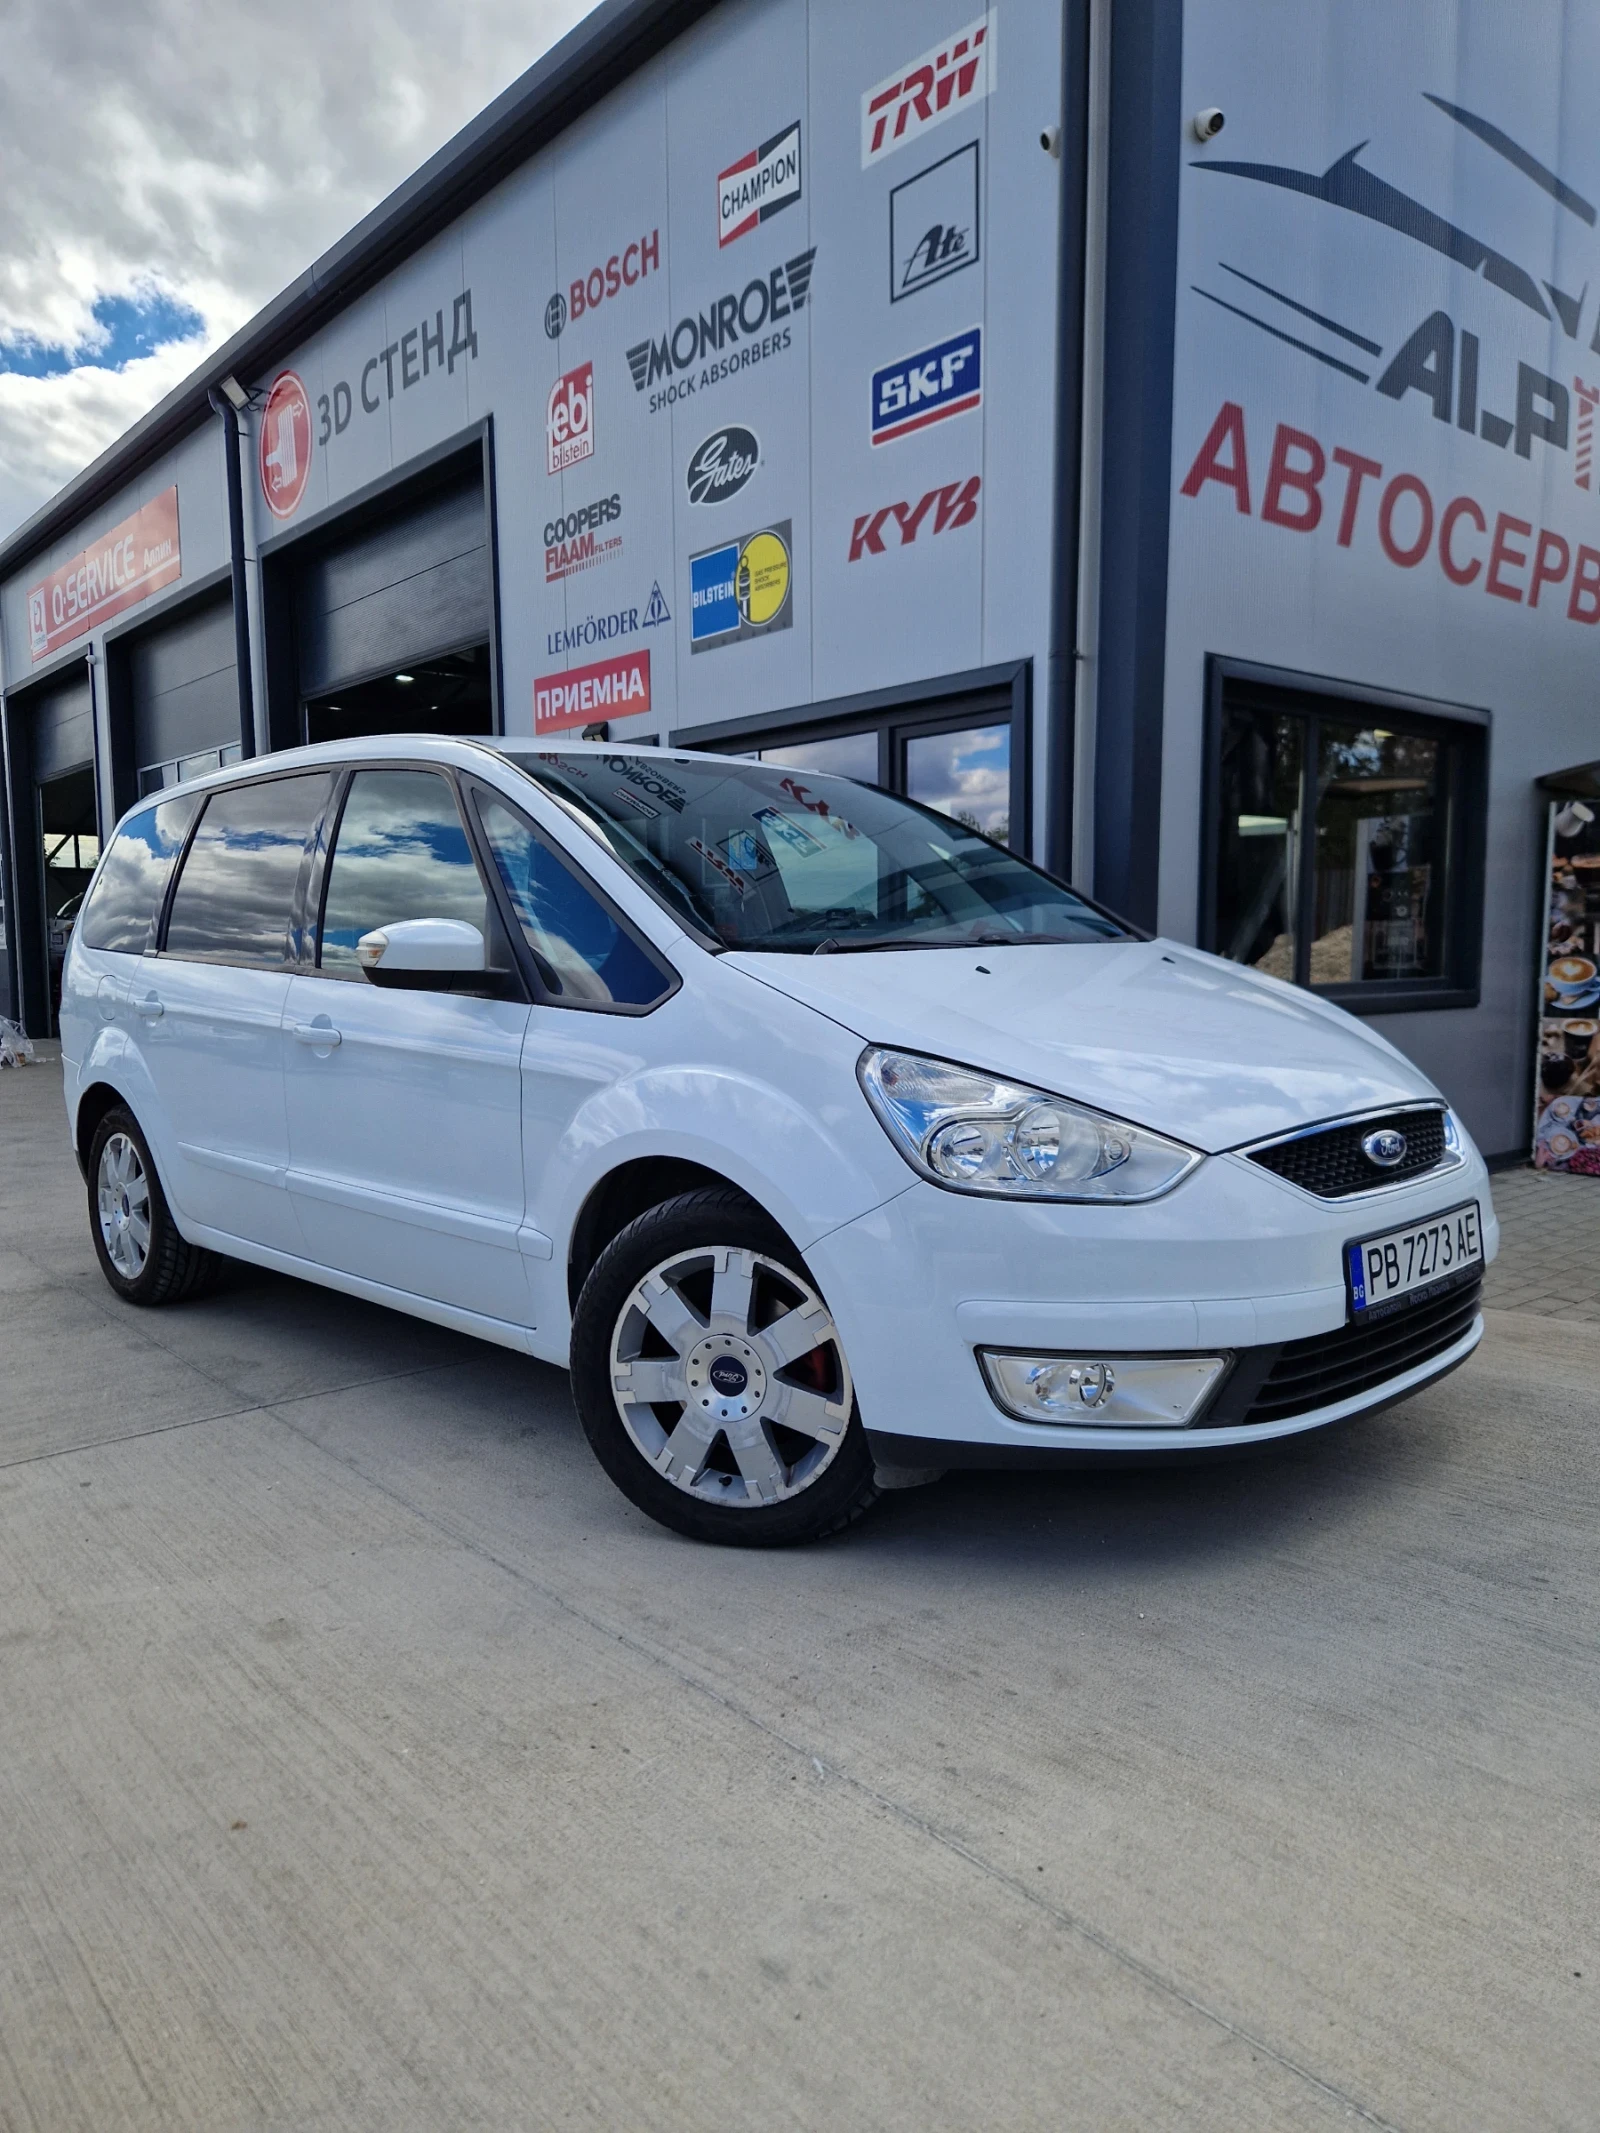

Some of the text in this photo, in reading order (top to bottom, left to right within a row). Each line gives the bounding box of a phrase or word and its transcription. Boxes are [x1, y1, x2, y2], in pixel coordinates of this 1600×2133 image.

[869, 26, 988, 154] TRW
[721, 148, 797, 220] CHAMPION
[569, 229, 660, 322] BOSCH
[902, 224, 970, 288] Ate
[646, 264, 792, 388] MONROE
[317, 288, 479, 447] 3D СТЕНД
[649, 326, 792, 415] SHOCK ABSORBERS
[878, 345, 975, 417] SKF
[552, 438, 590, 469] bilstein
[690, 435, 759, 503] Gates
[543, 493, 622, 548] COOPERS
[848, 474, 981, 562] KYB
[1180, 400, 1600, 626] АВТОСЕРВ
[545, 531, 623, 573] FIAAM FILTERS
[693, 580, 735, 608] BILSTEIN
[547, 608, 639, 656] LEMFÖRDER
[536, 667, 646, 720] ПРИЕМНА
[1381, 1136, 1401, 1156] Ford
[1367, 1247, 1400, 1296] PB
[1402, 1223, 1452, 1283] 7273
[1456, 1212, 1478, 1262] AE
[1353, 1284, 1365, 1301] BG
